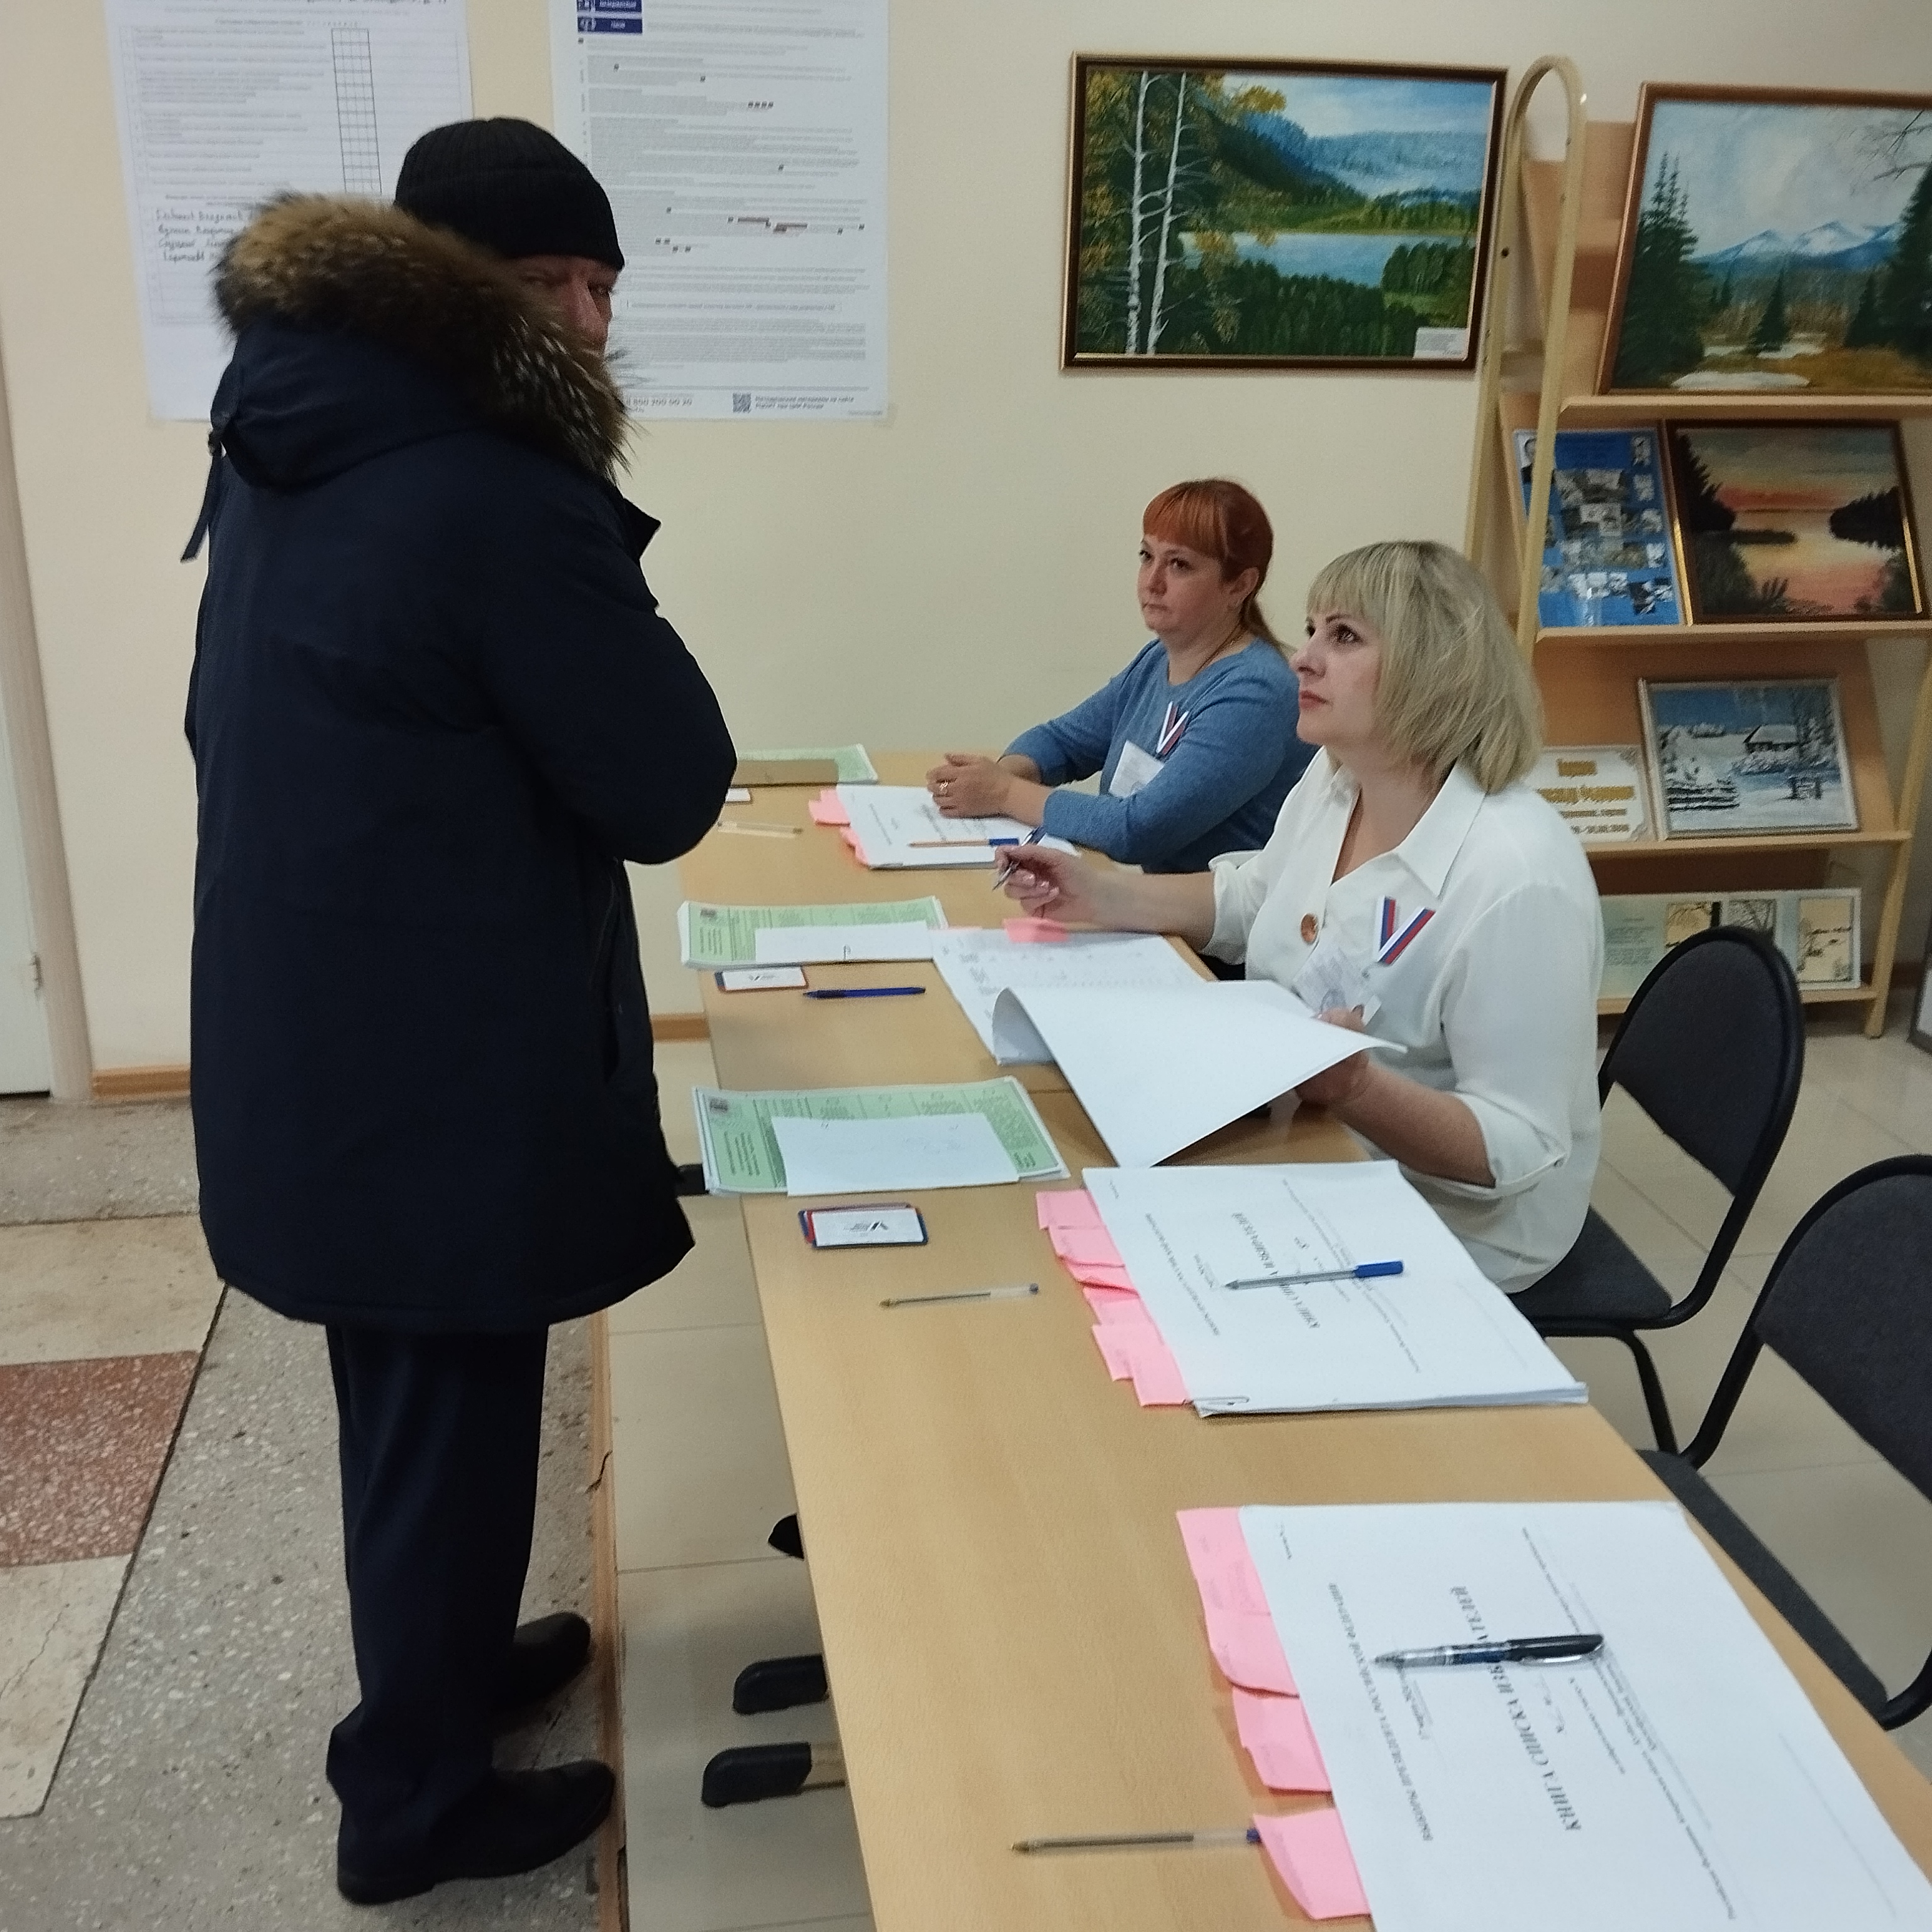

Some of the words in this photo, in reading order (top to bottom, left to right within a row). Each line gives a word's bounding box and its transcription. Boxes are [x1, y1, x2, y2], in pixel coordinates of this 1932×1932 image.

[1450, 1585, 1514, 1694] ИЗБАТЕЛЕЙ
[1507, 1697, 1550, 1766] СПИСКА
[1542, 1770, 1582, 1831] КНИГА
